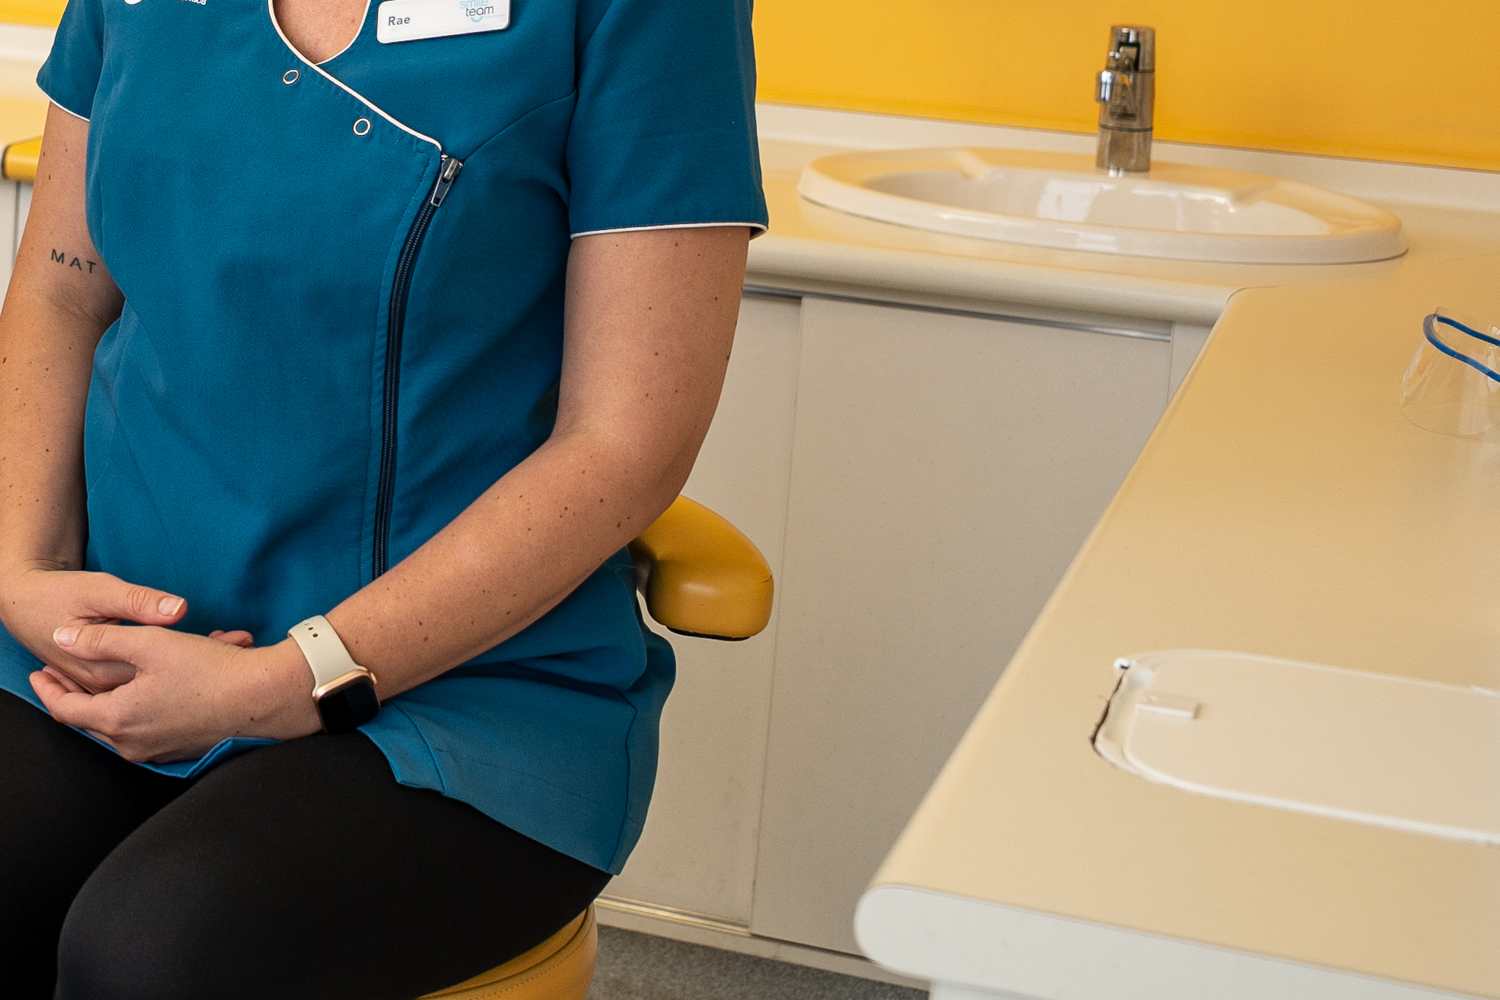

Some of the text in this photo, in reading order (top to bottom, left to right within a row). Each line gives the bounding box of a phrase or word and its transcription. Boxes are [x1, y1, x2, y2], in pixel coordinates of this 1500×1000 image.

[465, 5, 494, 17] team
[388, 15, 411, 27] Rae
[51, 249, 97, 274] MAT
